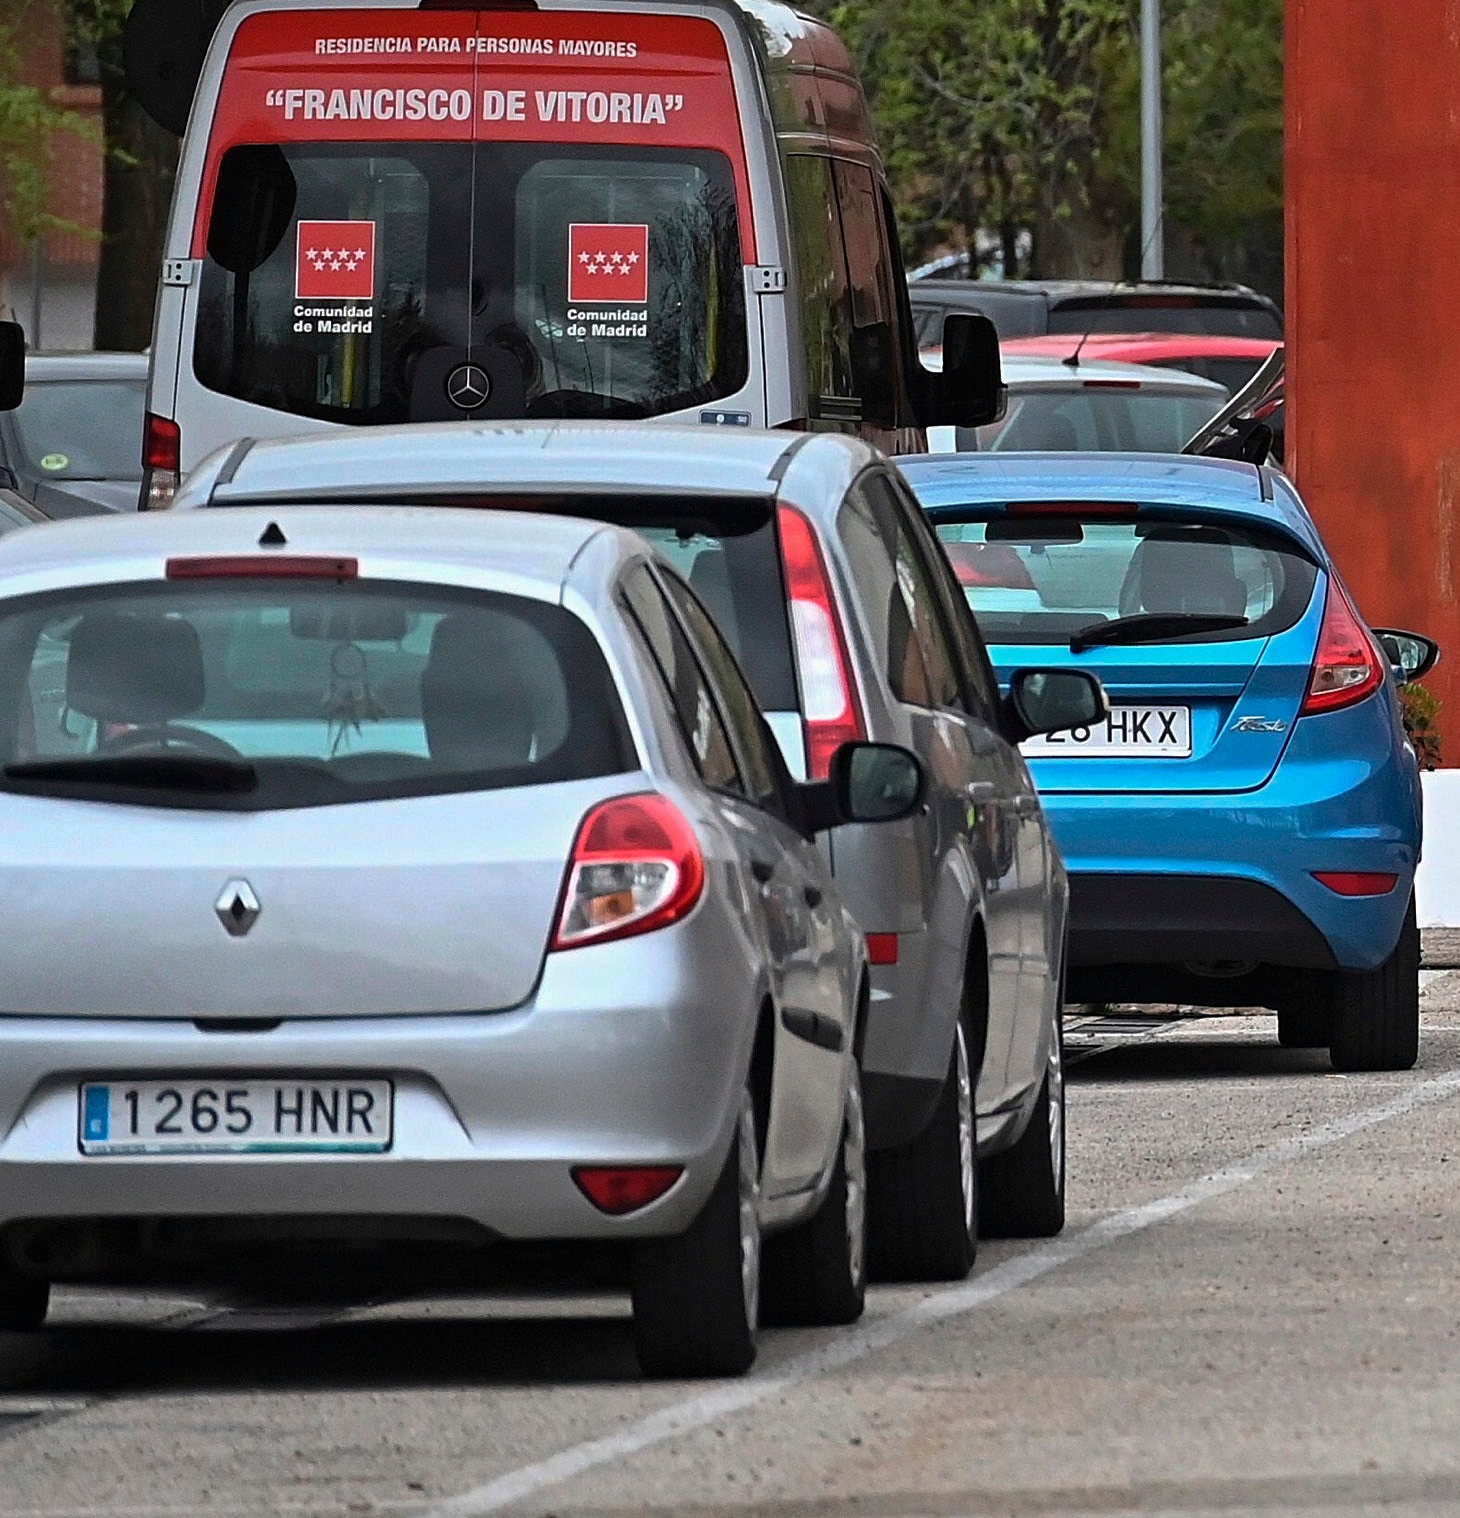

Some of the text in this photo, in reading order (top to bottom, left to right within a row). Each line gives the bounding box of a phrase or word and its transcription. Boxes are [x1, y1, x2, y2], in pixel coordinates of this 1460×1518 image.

[315, 38, 638, 58] RESIDENCIA PARA PERSONAS MAYORES
[265, 88, 684, 125] “FRANCISCO DE VITORIA”
[293, 305, 373, 318] Comunidad
[567, 308, 648, 321] Comunidad
[293, 319, 373, 333] de Madrid
[566, 323, 647, 337] de Madrid
[1106, 710, 1178, 744] HKX
[124, 1087, 375, 1135] 1265 HNR
